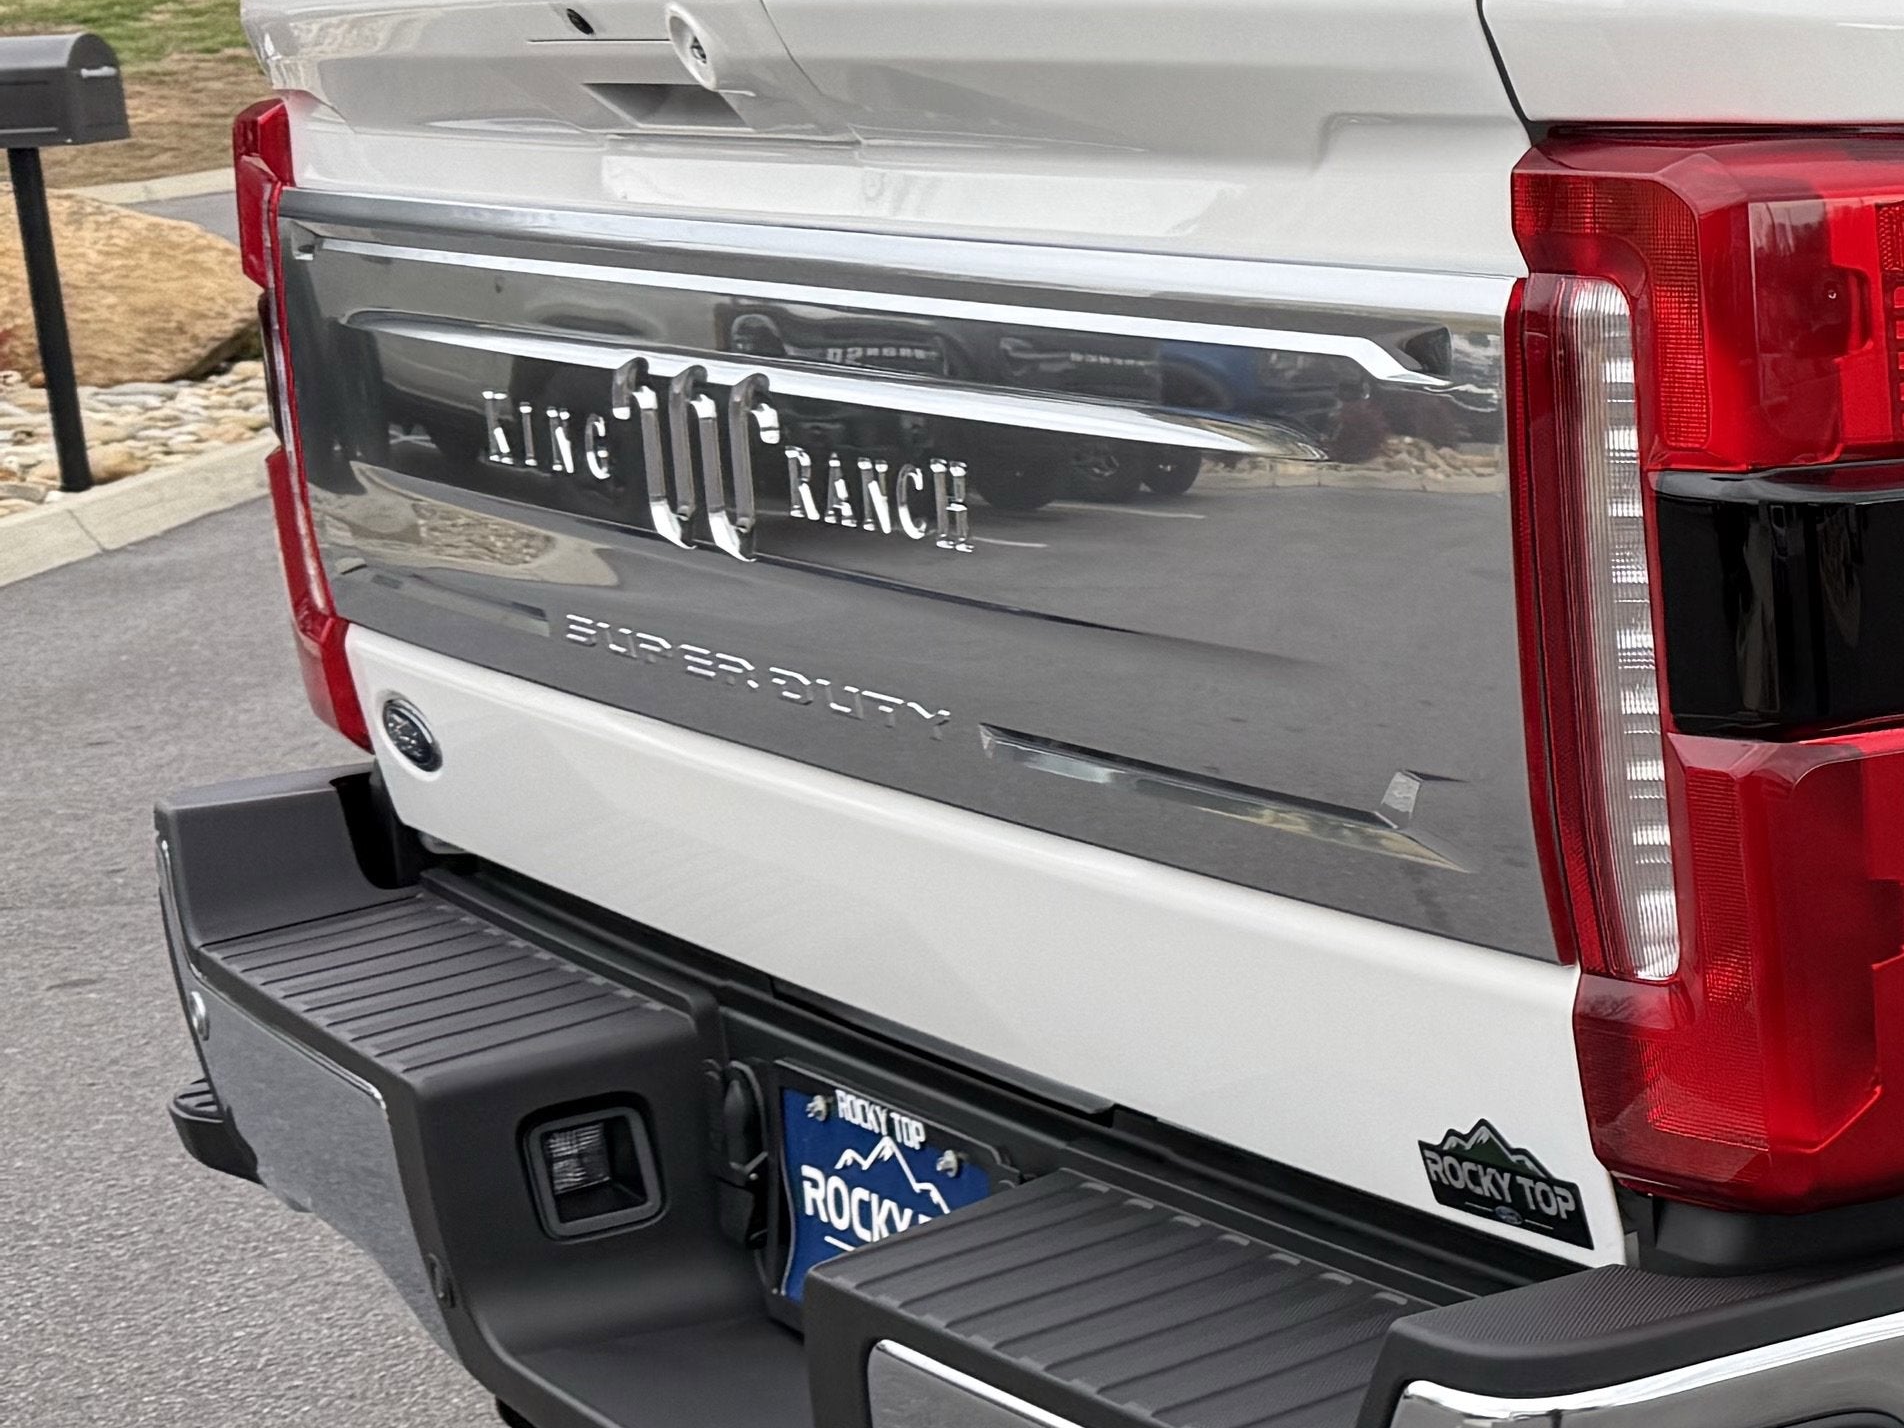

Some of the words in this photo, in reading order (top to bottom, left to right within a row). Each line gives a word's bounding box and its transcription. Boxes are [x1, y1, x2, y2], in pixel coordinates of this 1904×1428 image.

[482, 390, 611, 480] KING
[784, 445, 975, 553] RANCH
[566, 614, 759, 689] SUPER
[769, 666, 951, 741] DUTY
[835, 1088, 889, 1136] ROCKY
[889, 1111, 927, 1150] TOP
[801, 1164, 914, 1243] ROCKY
[1424, 1149, 1512, 1204] ROCKY
[1516, 1175, 1576, 1220] TOP
